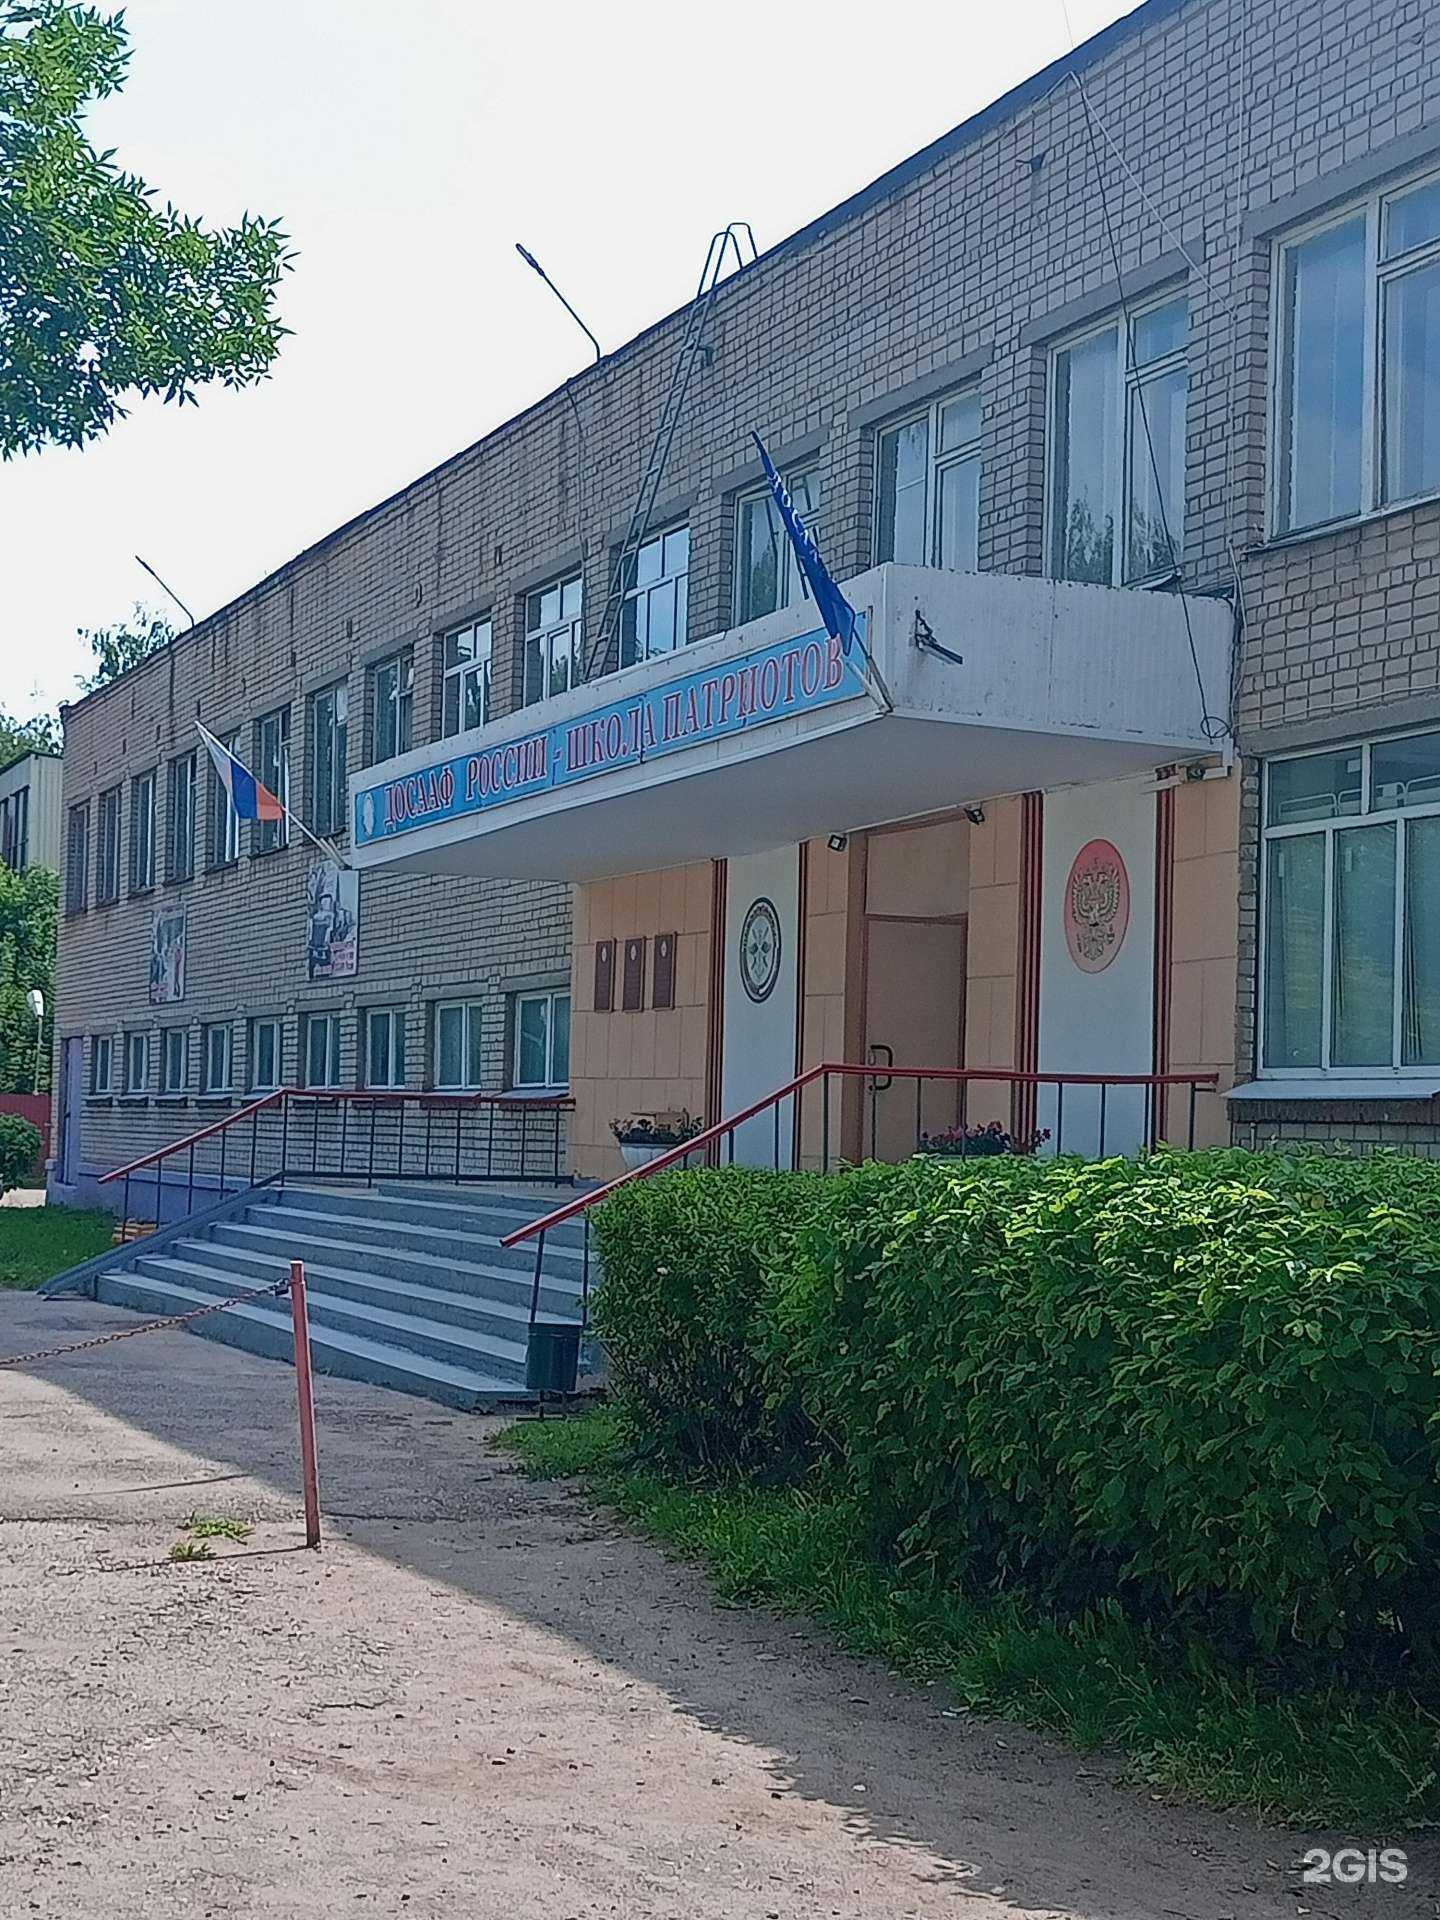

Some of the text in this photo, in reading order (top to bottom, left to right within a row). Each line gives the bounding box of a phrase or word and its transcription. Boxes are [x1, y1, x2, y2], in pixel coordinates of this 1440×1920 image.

[384, 765, 455, 832] ДОСААФ
[466, 734, 549, 801] РОССИИ
[566, 701, 658, 774] ШКОЛА
[662, 633, 845, 743] ПАТРИОТОВ
